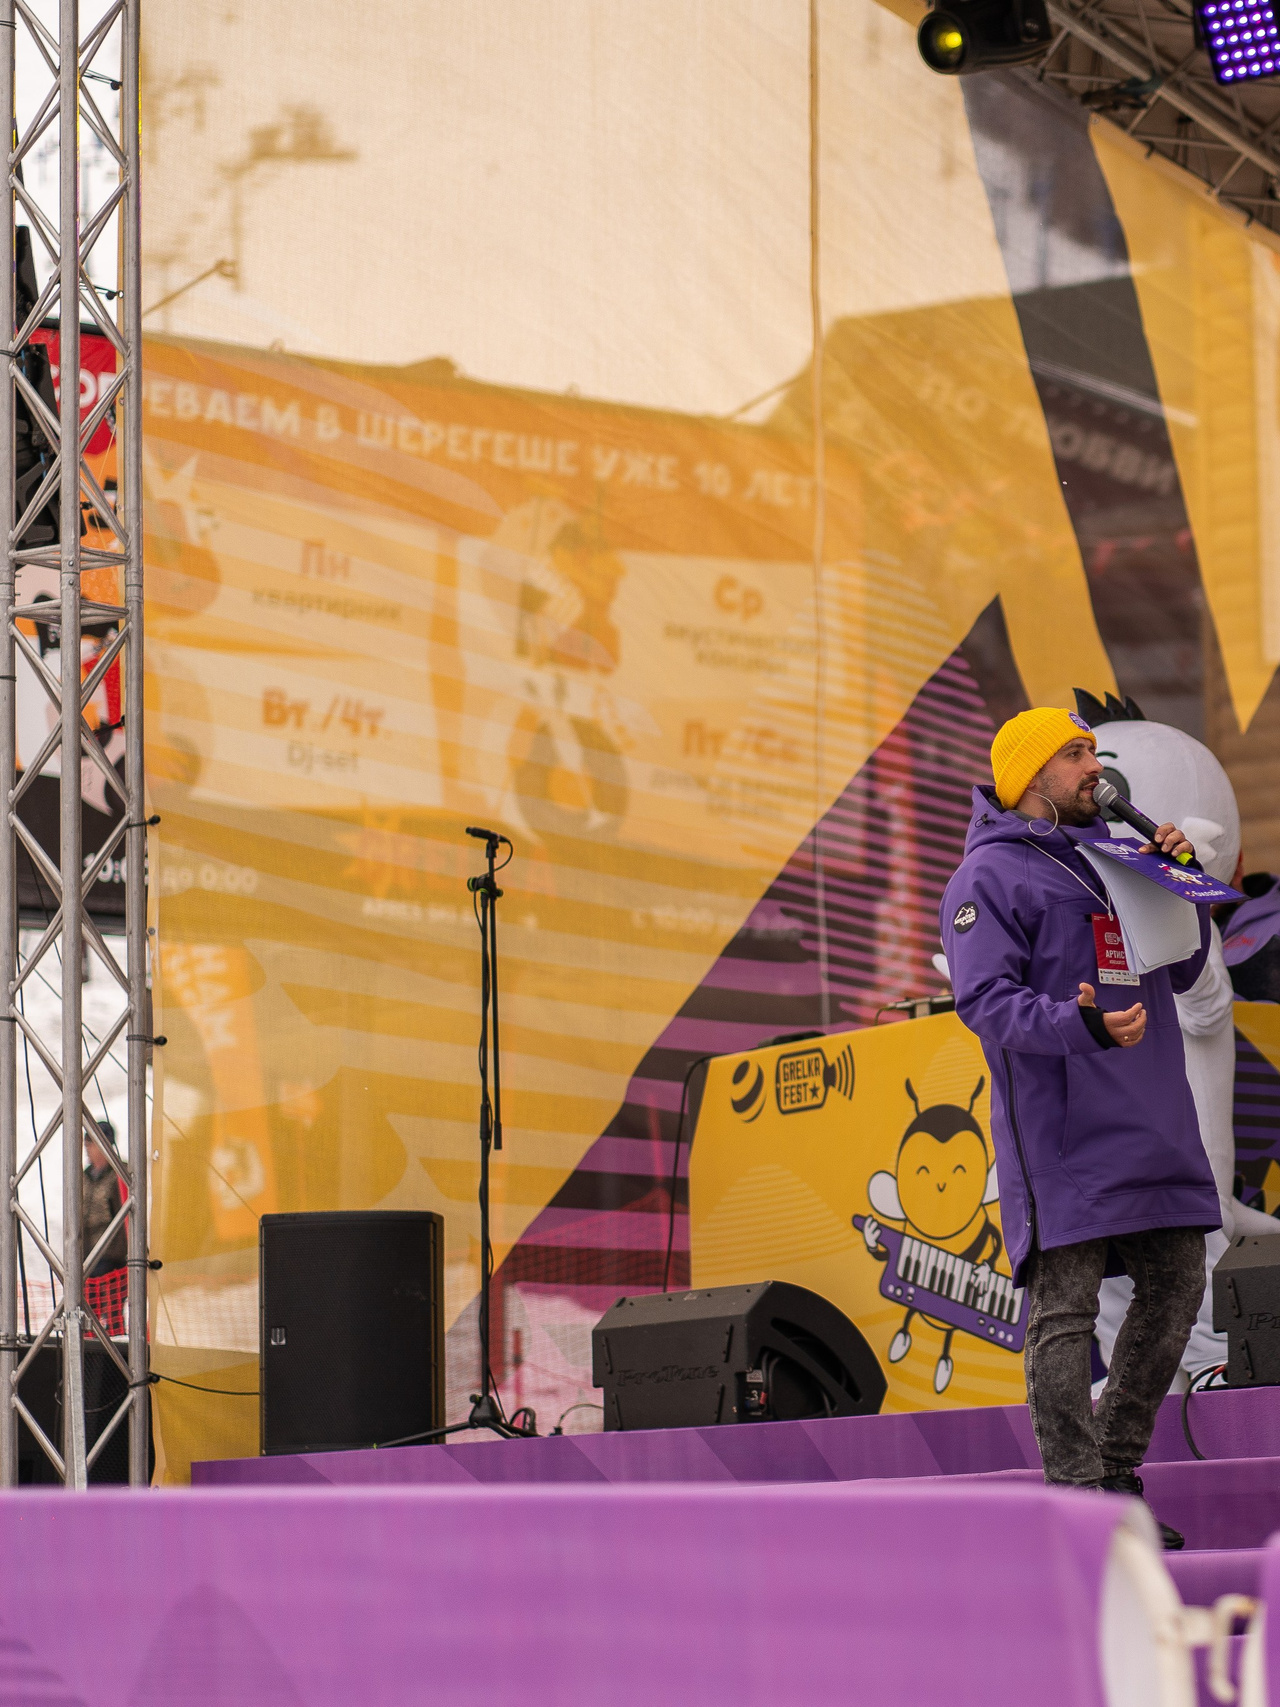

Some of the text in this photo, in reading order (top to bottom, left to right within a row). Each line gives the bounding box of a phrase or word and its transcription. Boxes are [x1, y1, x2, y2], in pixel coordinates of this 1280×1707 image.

[713, 573, 764, 623] Ср
[1105, 949, 1126, 959] АРТИС
[782, 1057, 821, 1082] GRELKA
[783, 1082, 809, 1106] FEST
[616, 1364, 719, 1388] ProTone
